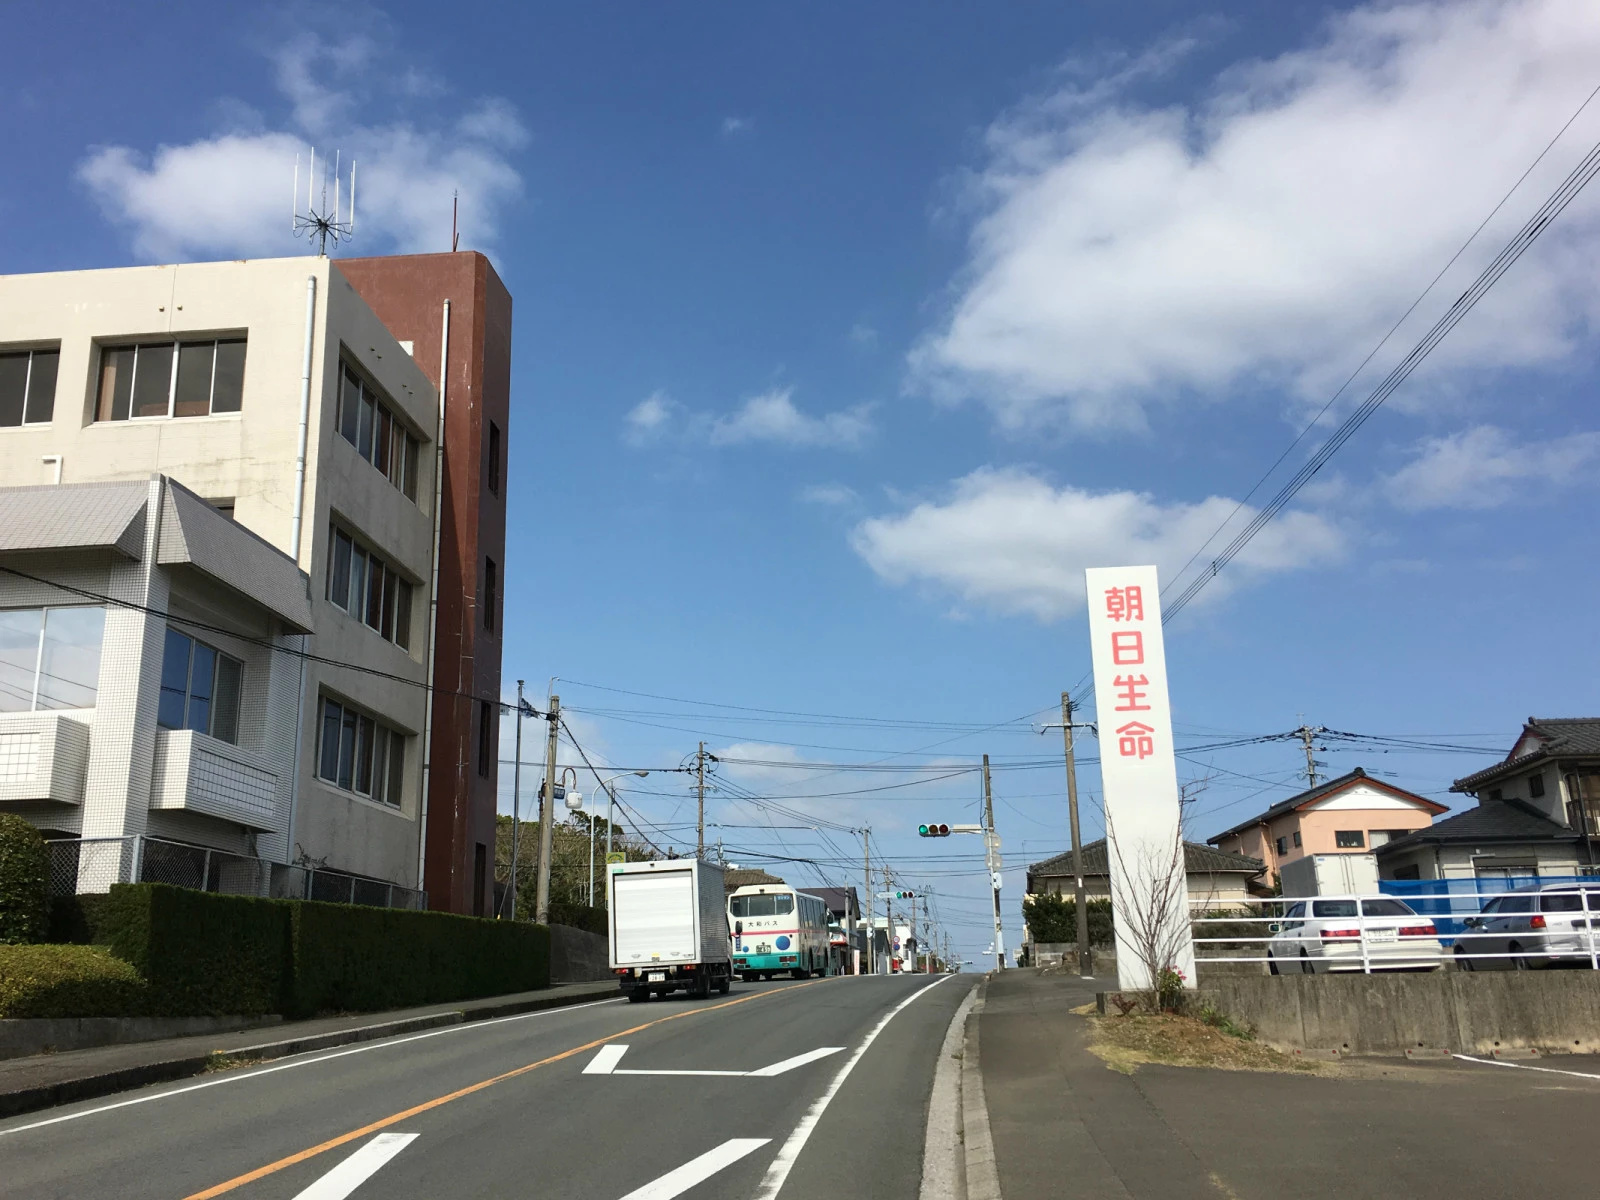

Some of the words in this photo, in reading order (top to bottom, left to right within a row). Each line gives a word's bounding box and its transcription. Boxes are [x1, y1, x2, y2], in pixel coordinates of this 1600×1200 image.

[1104, 585, 1155, 760] 朝日生命
[747, 920, 778, 928] 大和バス
